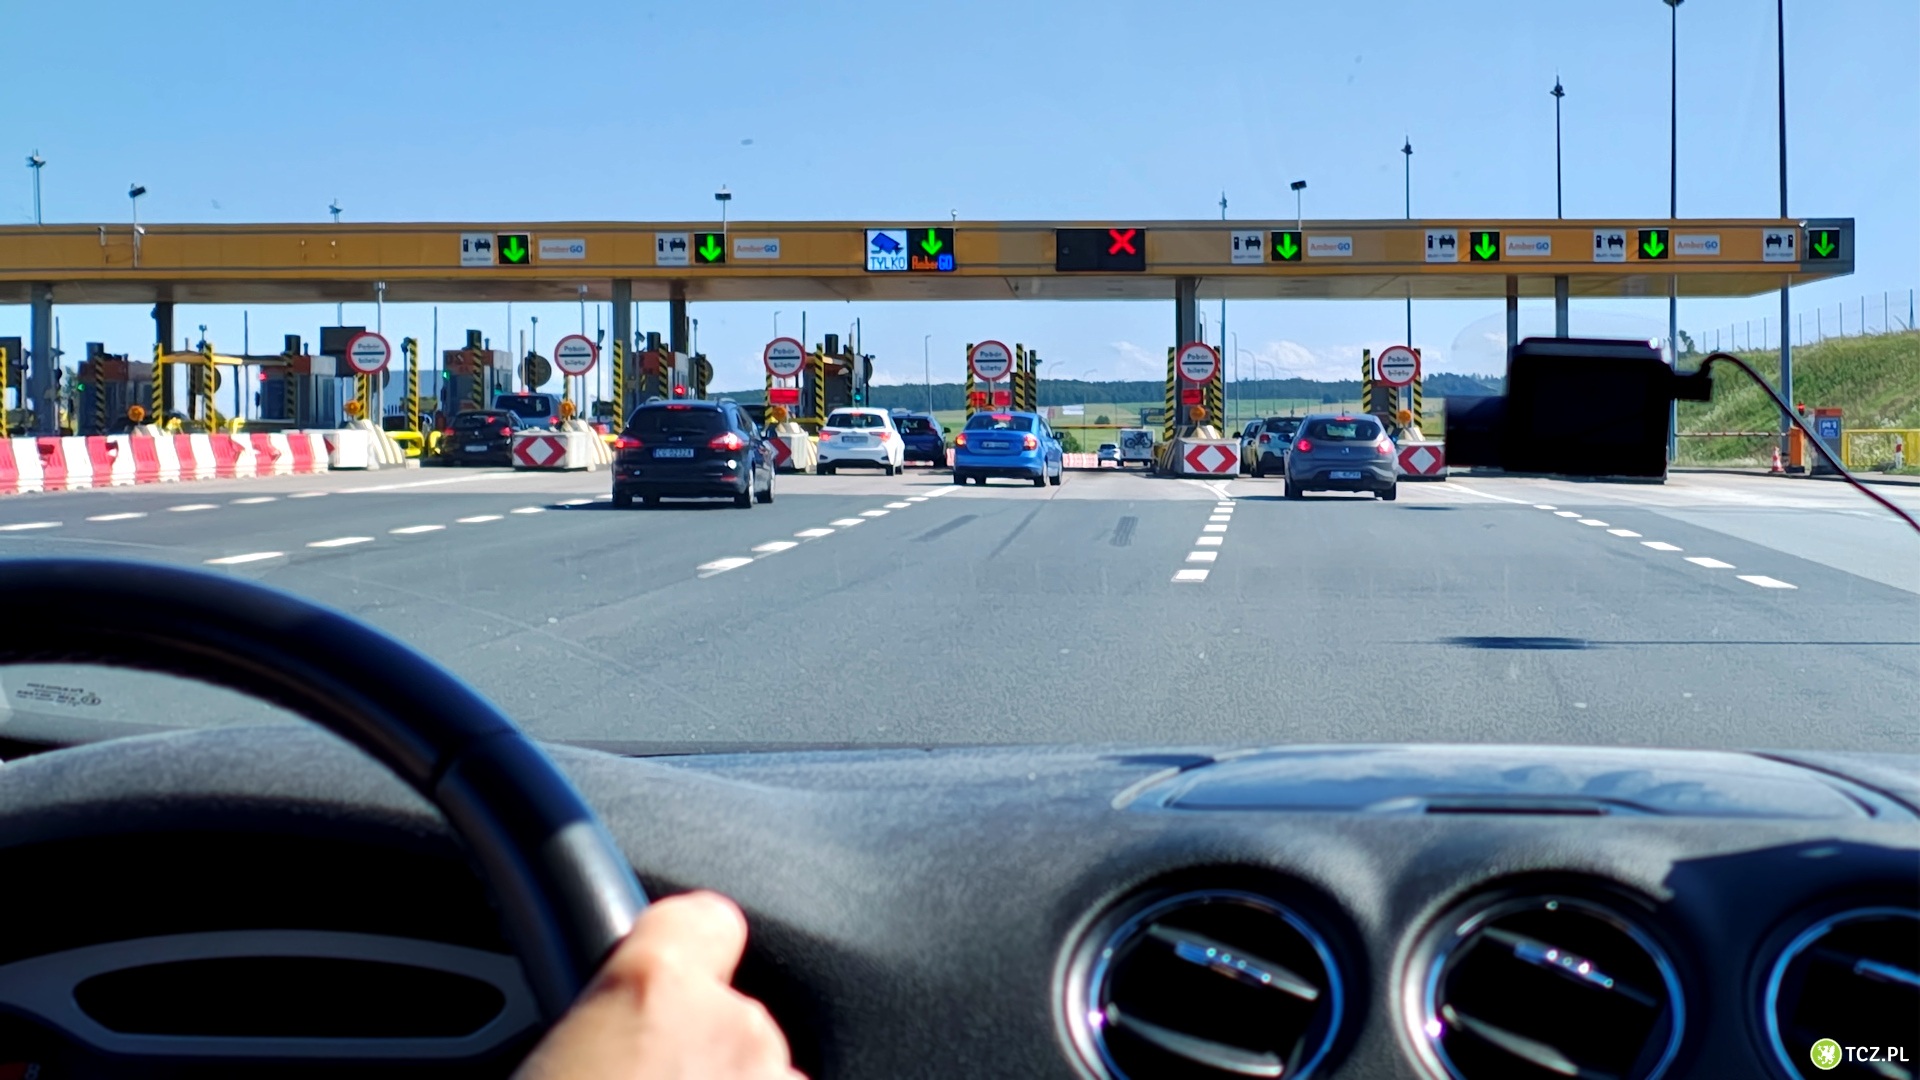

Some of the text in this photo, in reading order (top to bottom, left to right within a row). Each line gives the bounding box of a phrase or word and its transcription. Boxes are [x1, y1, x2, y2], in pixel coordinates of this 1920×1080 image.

[736, 244, 778, 253] AmberGO
[1310, 242, 1351, 251] AmberGO
[1508, 241, 1550, 250] AmberGO
[1677, 240, 1718, 249] AmberGO
[870, 257, 905, 269] TYLKO
[911, 254, 953, 270] AmberGO
